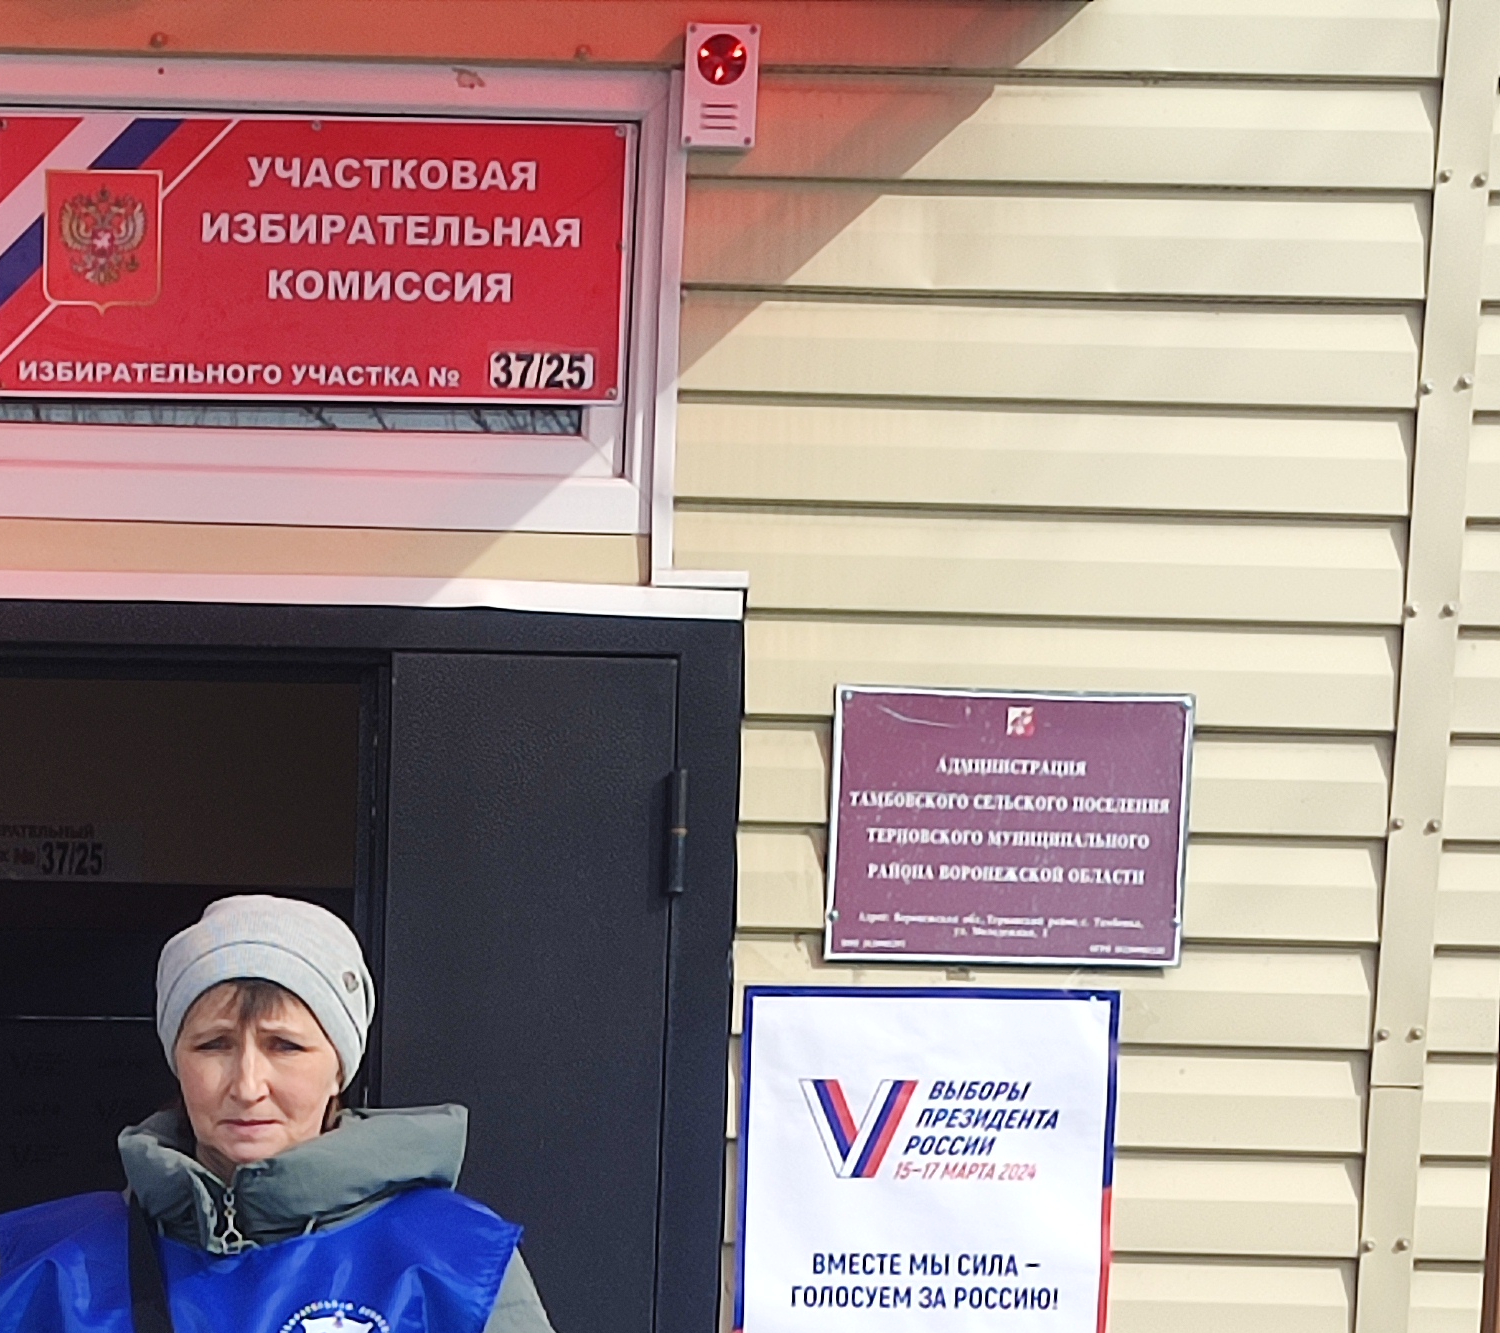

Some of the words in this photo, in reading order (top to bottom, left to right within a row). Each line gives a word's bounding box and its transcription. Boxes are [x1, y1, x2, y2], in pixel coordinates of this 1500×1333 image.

[247, 155, 537, 192] УЧАСТКОВАЯ
[200, 212, 581, 248] ИЗБИРАТЕЛЬНАЯ
[267, 269, 513, 303] КОМИССИЯ
[18, 361, 282, 387] ИЗБИРАТЕЛЬНОГО
[291, 363, 420, 388] УЧАСТКА
[493, 352, 587, 390] 37/25
[935, 755, 1087, 777] АДМИНИСТРАЦИЯ
[849, 790, 969, 810] ТАМБОВСКОГО
[973, 794, 1068, 812] СЕЛЬСКОГО
[1072, 796, 1170, 814] ПОСЕЛЕНИЯ
[866, 828, 983, 845] ТЕРНОВСКОГО
[987, 830, 1150, 849] МУНИЦИПАЛЬНОГО
[41, 841, 104, 875] 37/25
[867, 862, 933, 880] РАЙОНА
[939, 863, 1064, 883] ВОРОНЕЖСКОЙ
[1068, 867, 1145, 885] ОБЛАСТИ
[928, 1080, 1032, 1101] ВЫБОРЫ
[915, 1108, 1060, 1132] ПРЕЗИДЕНТА
[902, 1135, 997, 1156] РОССИИ
[940, 1162, 995, 1181] МАРТА
[997, 1163, 1038, 1181] 2024
[812, 1253, 902, 1275] ВМЕСТЕ
[909, 1253, 950, 1276] МЫ
[957, 1253, 1019, 1276] СИЛА
[791, 1285, 912, 1308] ГОЛОСУЕМ
[918, 1286, 947, 1309] ЗА
[954, 1287, 1059, 1310] РОССИЮ!
